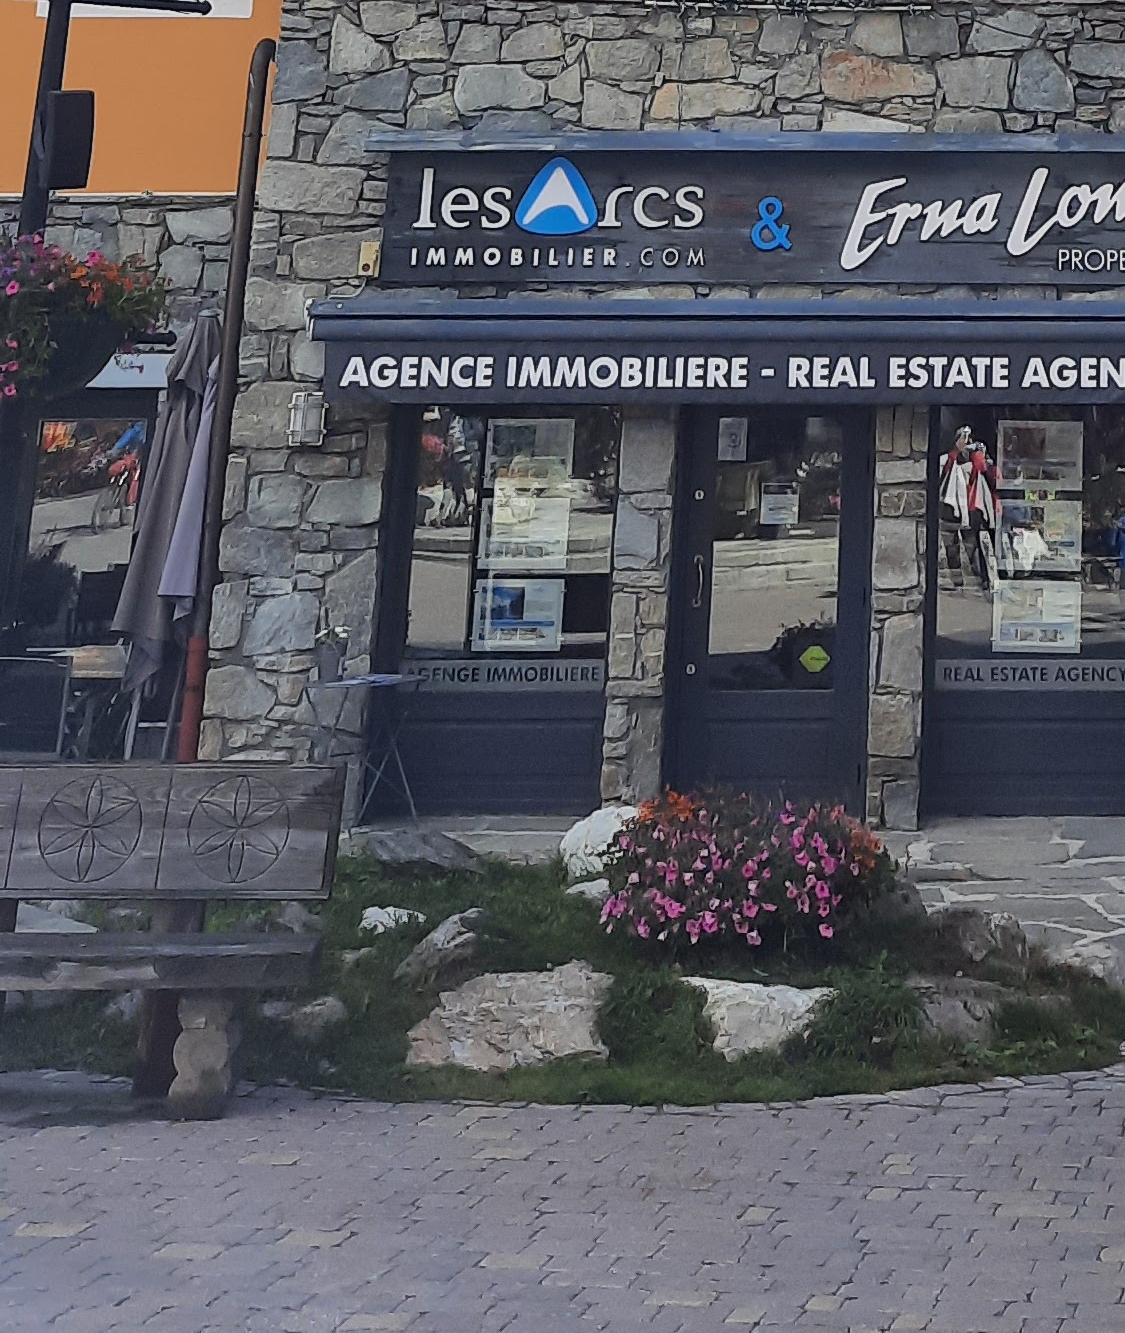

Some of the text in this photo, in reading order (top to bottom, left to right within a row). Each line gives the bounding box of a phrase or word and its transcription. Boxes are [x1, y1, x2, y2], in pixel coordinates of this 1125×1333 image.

[749, 197, 794, 253] &
[840, 176, 1000, 271] Erna
[339, 356, 495, 389] AGENCE
[504, 356, 750, 389] IMMOBILIERE
[788, 356, 876, 389] REAL
[888, 356, 1010, 389] ESTATE
[486, 666, 600, 683] IMMOBILIERE
[943, 666, 984, 683] REAL
[991, 666, 1048, 683] ESTATE
